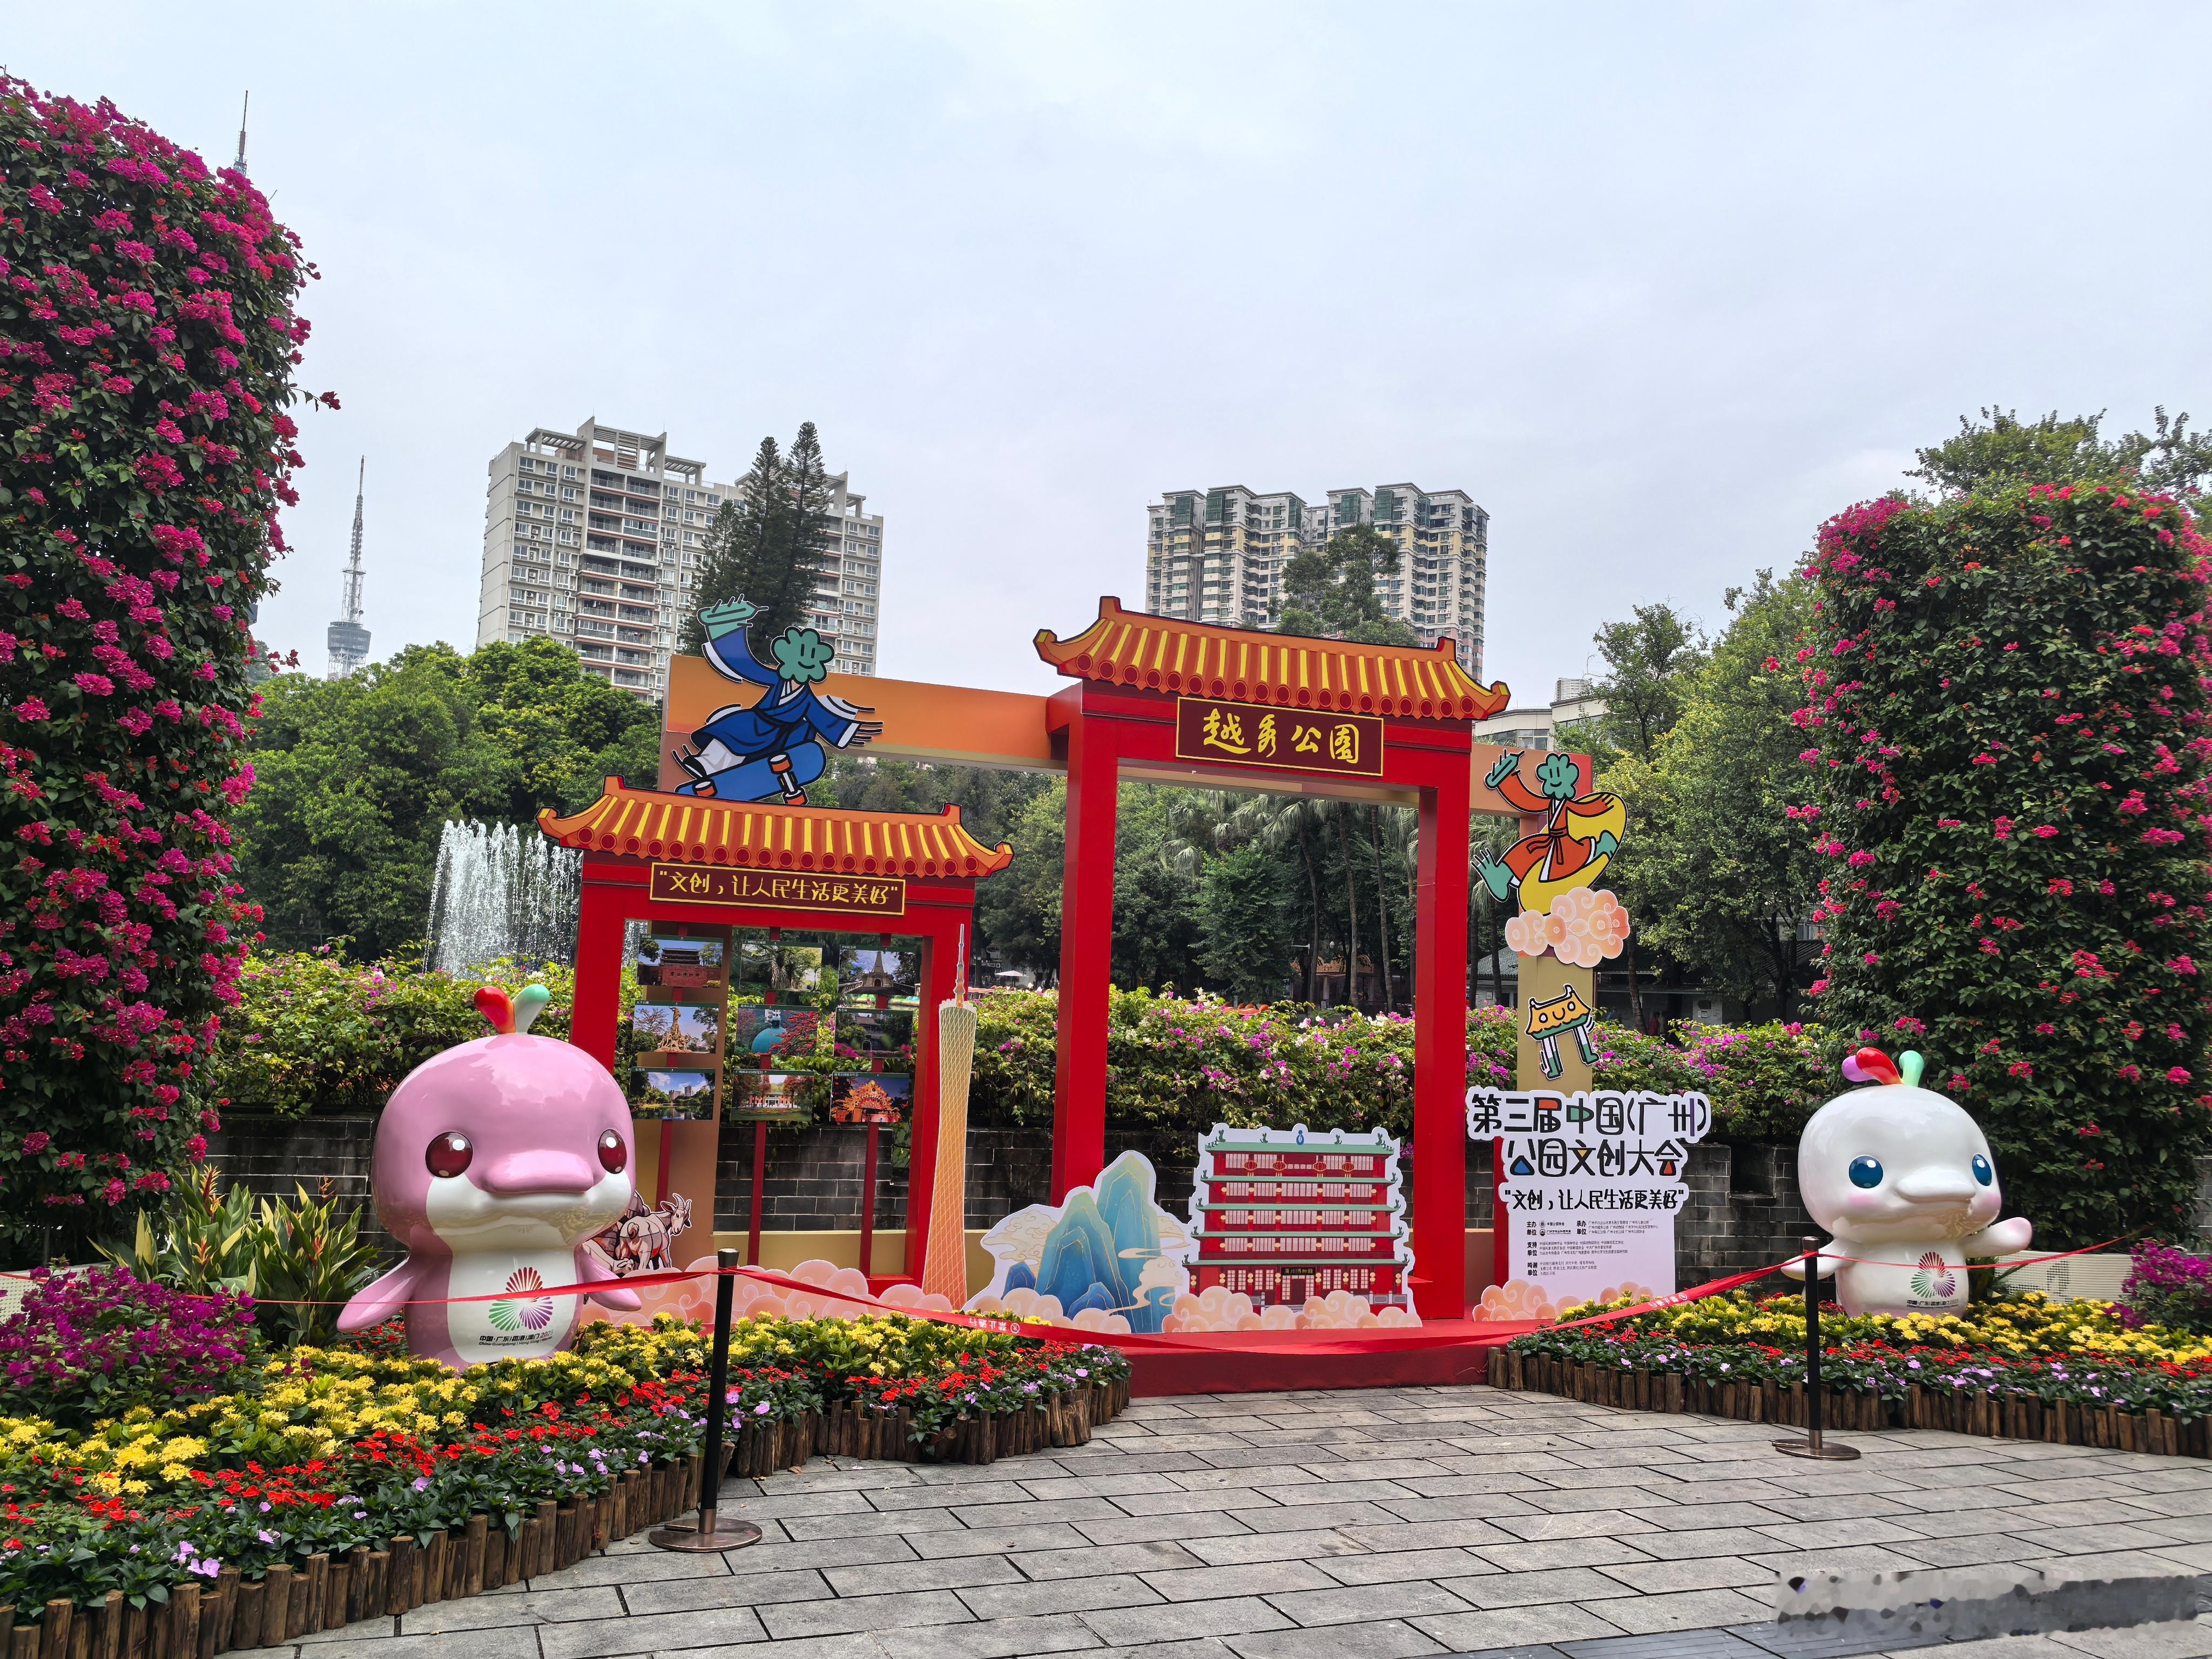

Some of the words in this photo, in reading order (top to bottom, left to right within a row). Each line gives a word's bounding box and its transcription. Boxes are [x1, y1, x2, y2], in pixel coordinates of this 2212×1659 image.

[659, 871, 898, 905] "文创，让人民生活更美好"
[1472, 1093, 1706, 1137] 第三届中国(广州)
[1508, 1138, 1683, 1176] 公园文创大会
[1505, 1189, 1684, 1210] "文创，让人民生活更美好"
